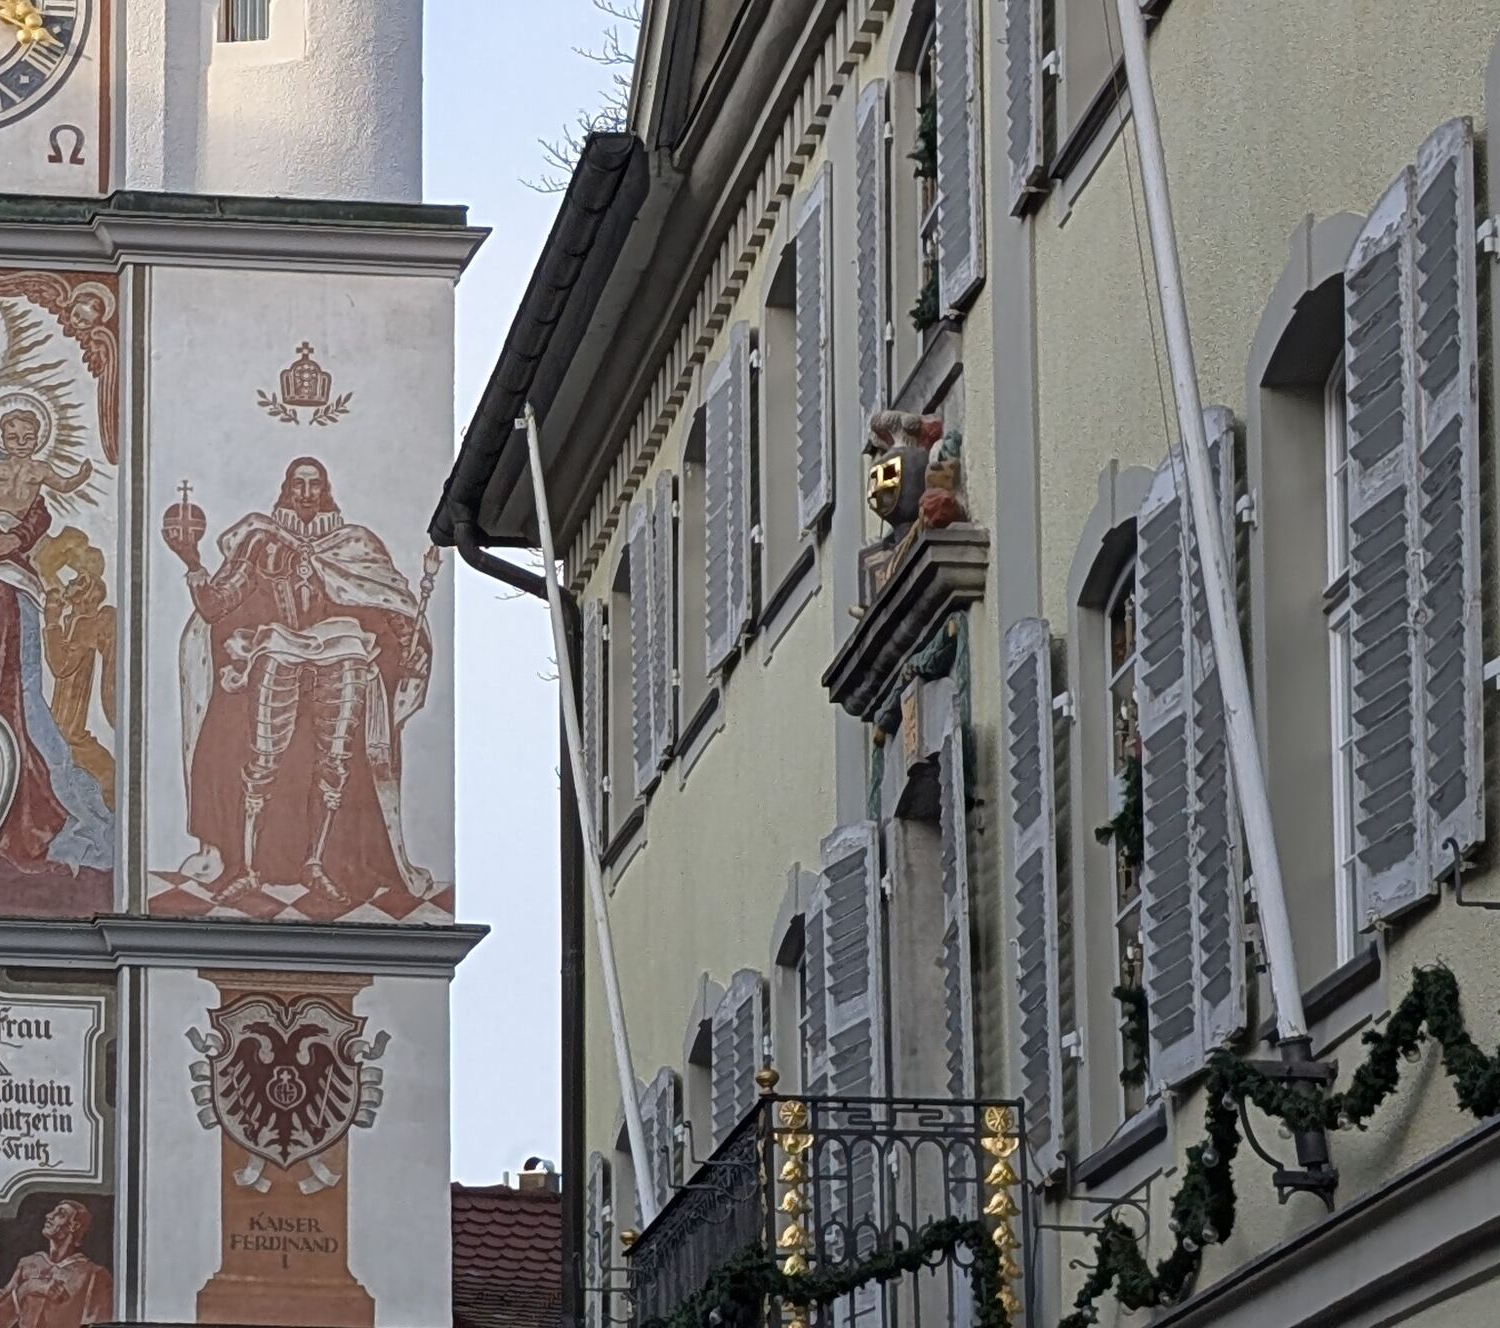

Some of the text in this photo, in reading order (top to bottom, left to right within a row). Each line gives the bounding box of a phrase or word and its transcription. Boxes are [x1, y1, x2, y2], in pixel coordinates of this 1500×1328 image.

[47, 124, 85, 165] Ω
[0, 1135, 64, 1168] Trutz
[249, 1213, 323, 1233] KAISER
[230, 1234, 338, 1253] FERDINAND
